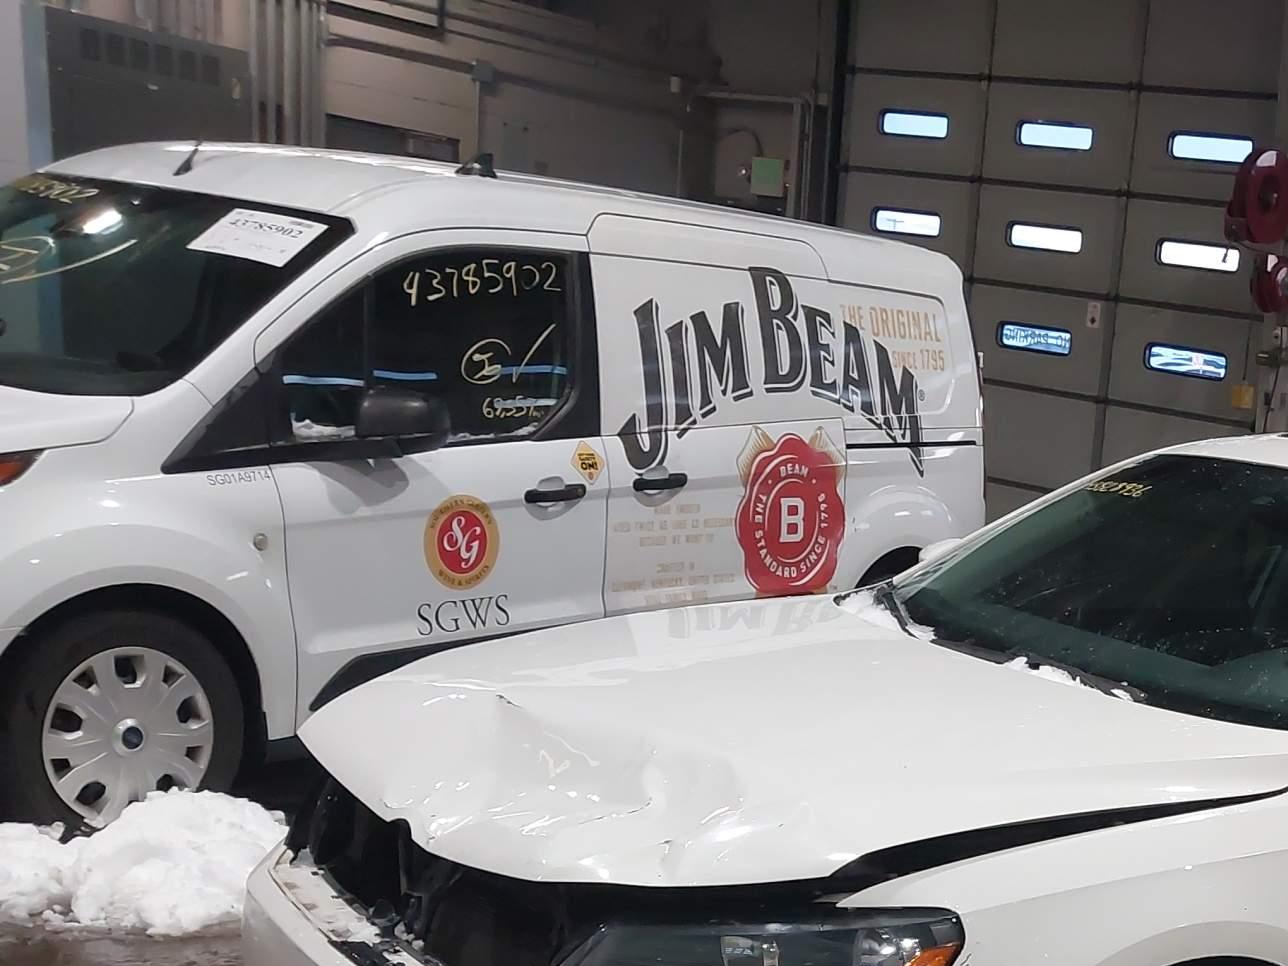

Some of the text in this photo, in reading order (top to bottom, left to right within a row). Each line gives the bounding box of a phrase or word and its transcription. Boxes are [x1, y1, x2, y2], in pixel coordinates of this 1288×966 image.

[402, 259, 563, 307] 43785902
[869, 306, 942, 342] ORIGINAL
[617, 266, 924, 478] JIM BEAM
[779, 463, 809, 478] BEAM
[754, 494, 767, 524] THE
[778, 497, 805, 543] B
[754, 529, 798, 579] STANDARD
[800, 534, 827, 573] SINCE
[416, 594, 511, 637] SGWS
